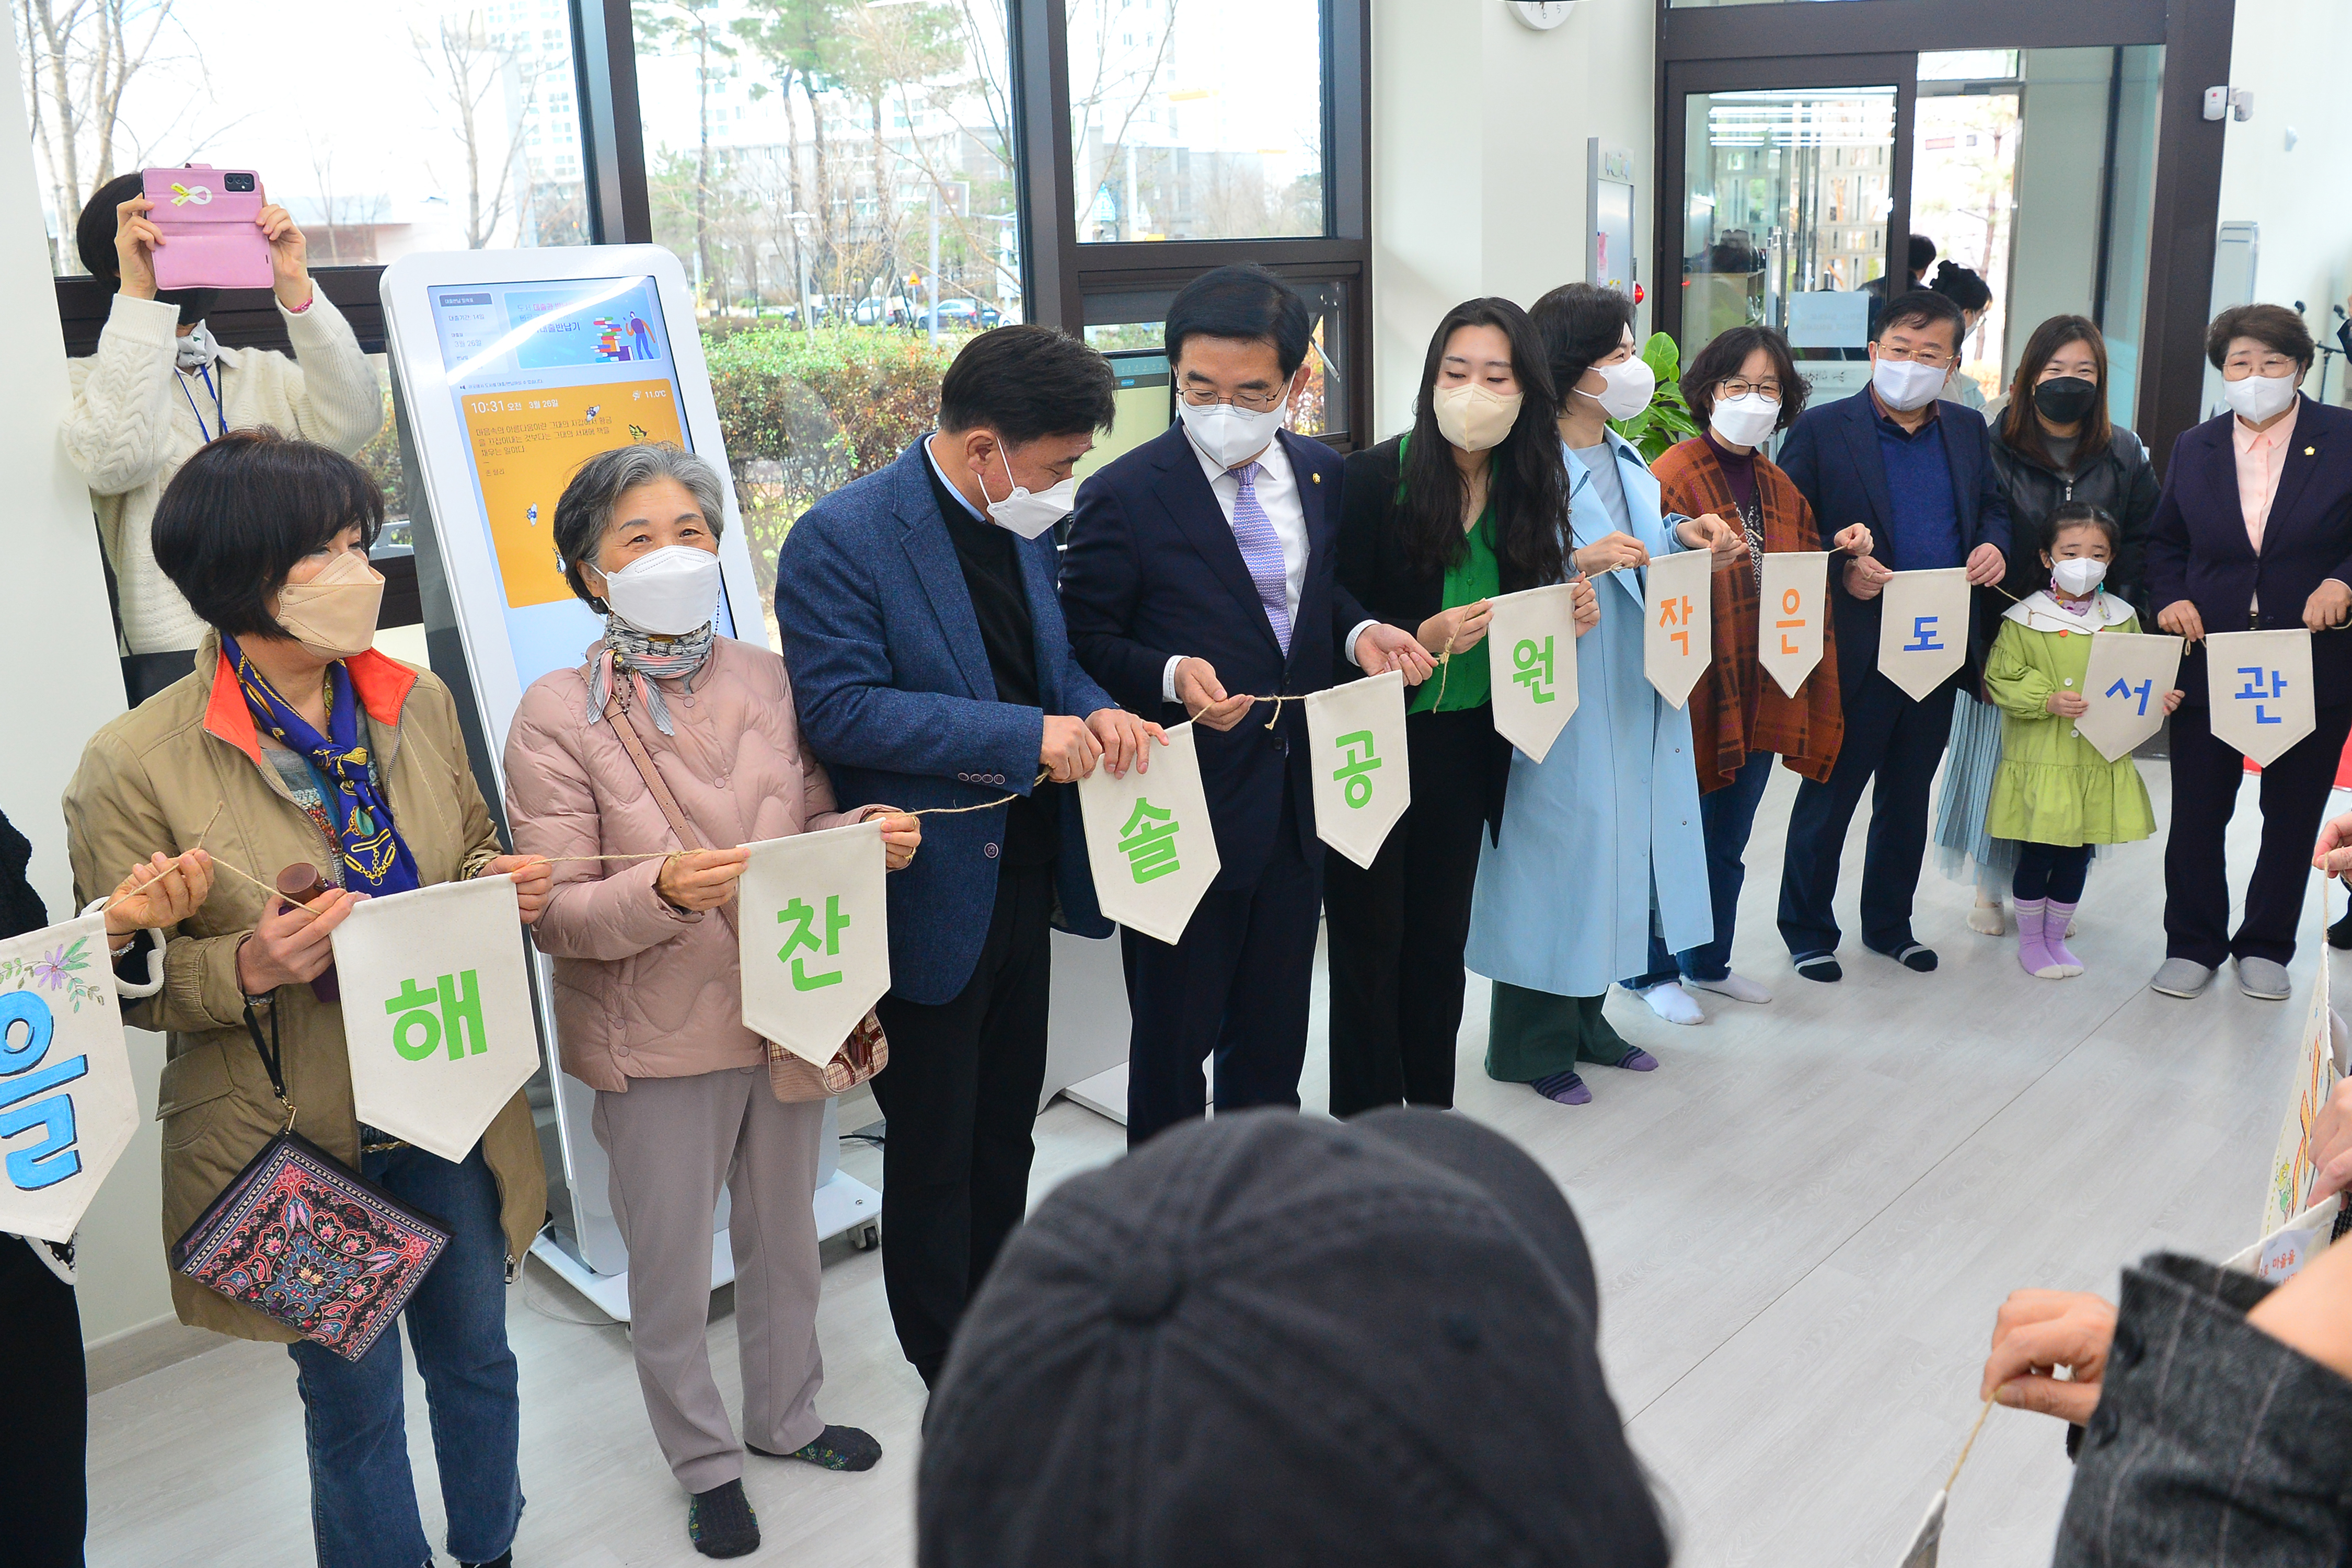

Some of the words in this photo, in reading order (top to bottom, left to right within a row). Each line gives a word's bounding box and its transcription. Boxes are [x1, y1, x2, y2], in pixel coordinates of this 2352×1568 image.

[1542, 9, 1547, 19] 6
[1557, 4, 1561, 14] 5
[471, 400, 504, 413] 10:31
[508, 402, 522, 411] 오전
[542, 399, 559, 408] 26일
[476, 426, 504, 436] 마음속의
[506, 422, 547, 433] 아름다움이란
[549, 419, 569, 429] 그대의
[525, 433, 552, 442] 것보다는
[554, 430, 574, 440] 그대의
[575, 427, 595, 436] 서재에
[597, 426, 609, 434] 책을
[481, 448, 502, 457] 채우는
[1659, 595, 1693, 656] 작
[1776, 589, 1806, 654] 은
[1904, 616, 1944, 651] 도
[1513, 636, 1554, 704] 원
[2105, 678, 2152, 716] 서
[2235, 667, 2287, 724] 관
[1333, 730, 1382, 809] 공
[1118, 797, 1180, 884] 솔
[777, 894, 850, 991] 찬
[385, 969, 487, 1061] 해
